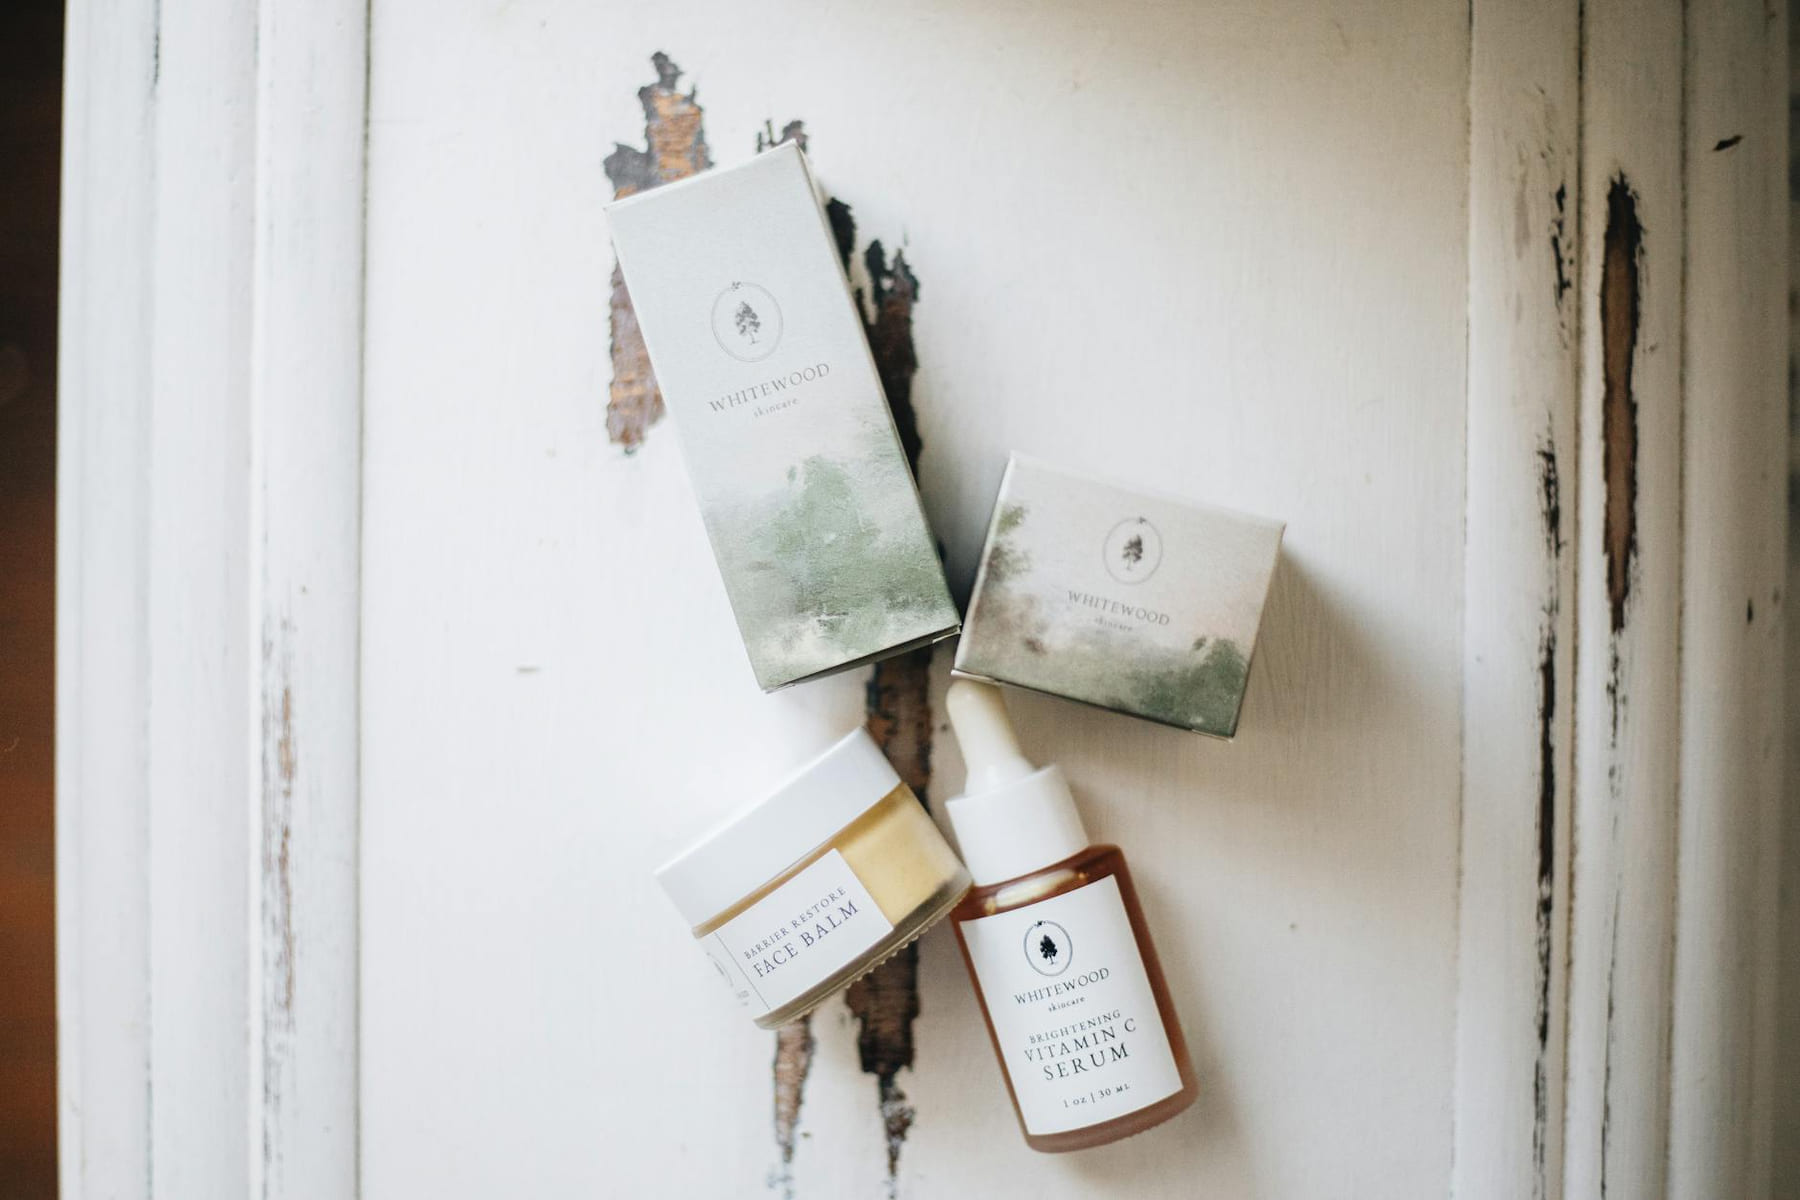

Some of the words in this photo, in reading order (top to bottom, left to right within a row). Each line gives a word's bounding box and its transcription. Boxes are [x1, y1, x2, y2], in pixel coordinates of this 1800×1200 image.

[708, 363, 830, 412] WHITEWOOD
[753, 398, 799, 418] skincare
[1068, 590, 1170, 626] WHITEWOOD
[744, 927, 790, 960] BARRIER
[791, 886, 847, 928] RESTORE
[753, 942, 799, 978] FACE
[800, 900, 859, 947] BALM
[1014, 967, 1110, 1005] WHITEWOOD
[1048, 996, 1086, 1013] skincare
[1024, 1026, 1116, 1062] VITAMIN
[1124, 1017, 1137, 1033] C
[1029, 1009, 1121, 1045] BRIGHTENING
[1042, 1042, 1130, 1081] SERUM
[1098, 1086, 1111, 1099] 30
